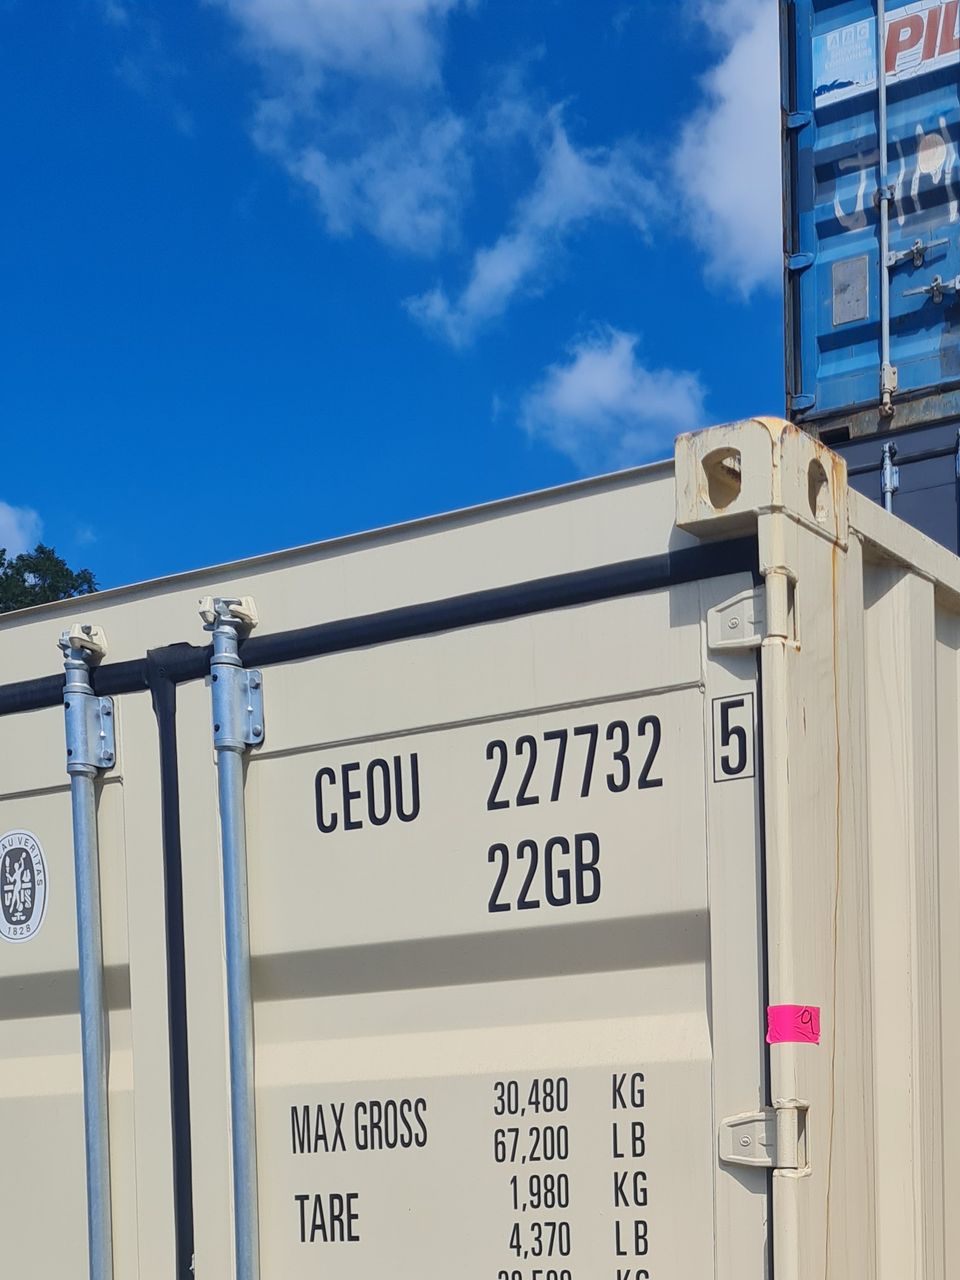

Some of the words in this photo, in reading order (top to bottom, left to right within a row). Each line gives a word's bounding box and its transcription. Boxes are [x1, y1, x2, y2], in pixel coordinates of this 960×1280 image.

[314, 753, 420, 834] CEOU
[485, 714, 663, 811] 227732
[720, 698, 748, 776] 5
[17, 836, 44, 886] VERITAS
[487, 832, 601, 913] 22GB
[291, 1103, 347, 1154] MAX
[354, 1098, 428, 1151] GROSS
[493, 1077, 568, 1117] 30,480
[612, 1072, 645, 1109] KG
[493, 1125, 569, 1165] 67,200
[612, 1121, 645, 1158] LB
[294, 1193, 360, 1243] TARE
[509, 1173, 569, 1212] 1,980
[613, 1171, 648, 1207] KG
[509, 1222, 571, 1259] 4,370
[615, 1220, 649, 1256] LB
